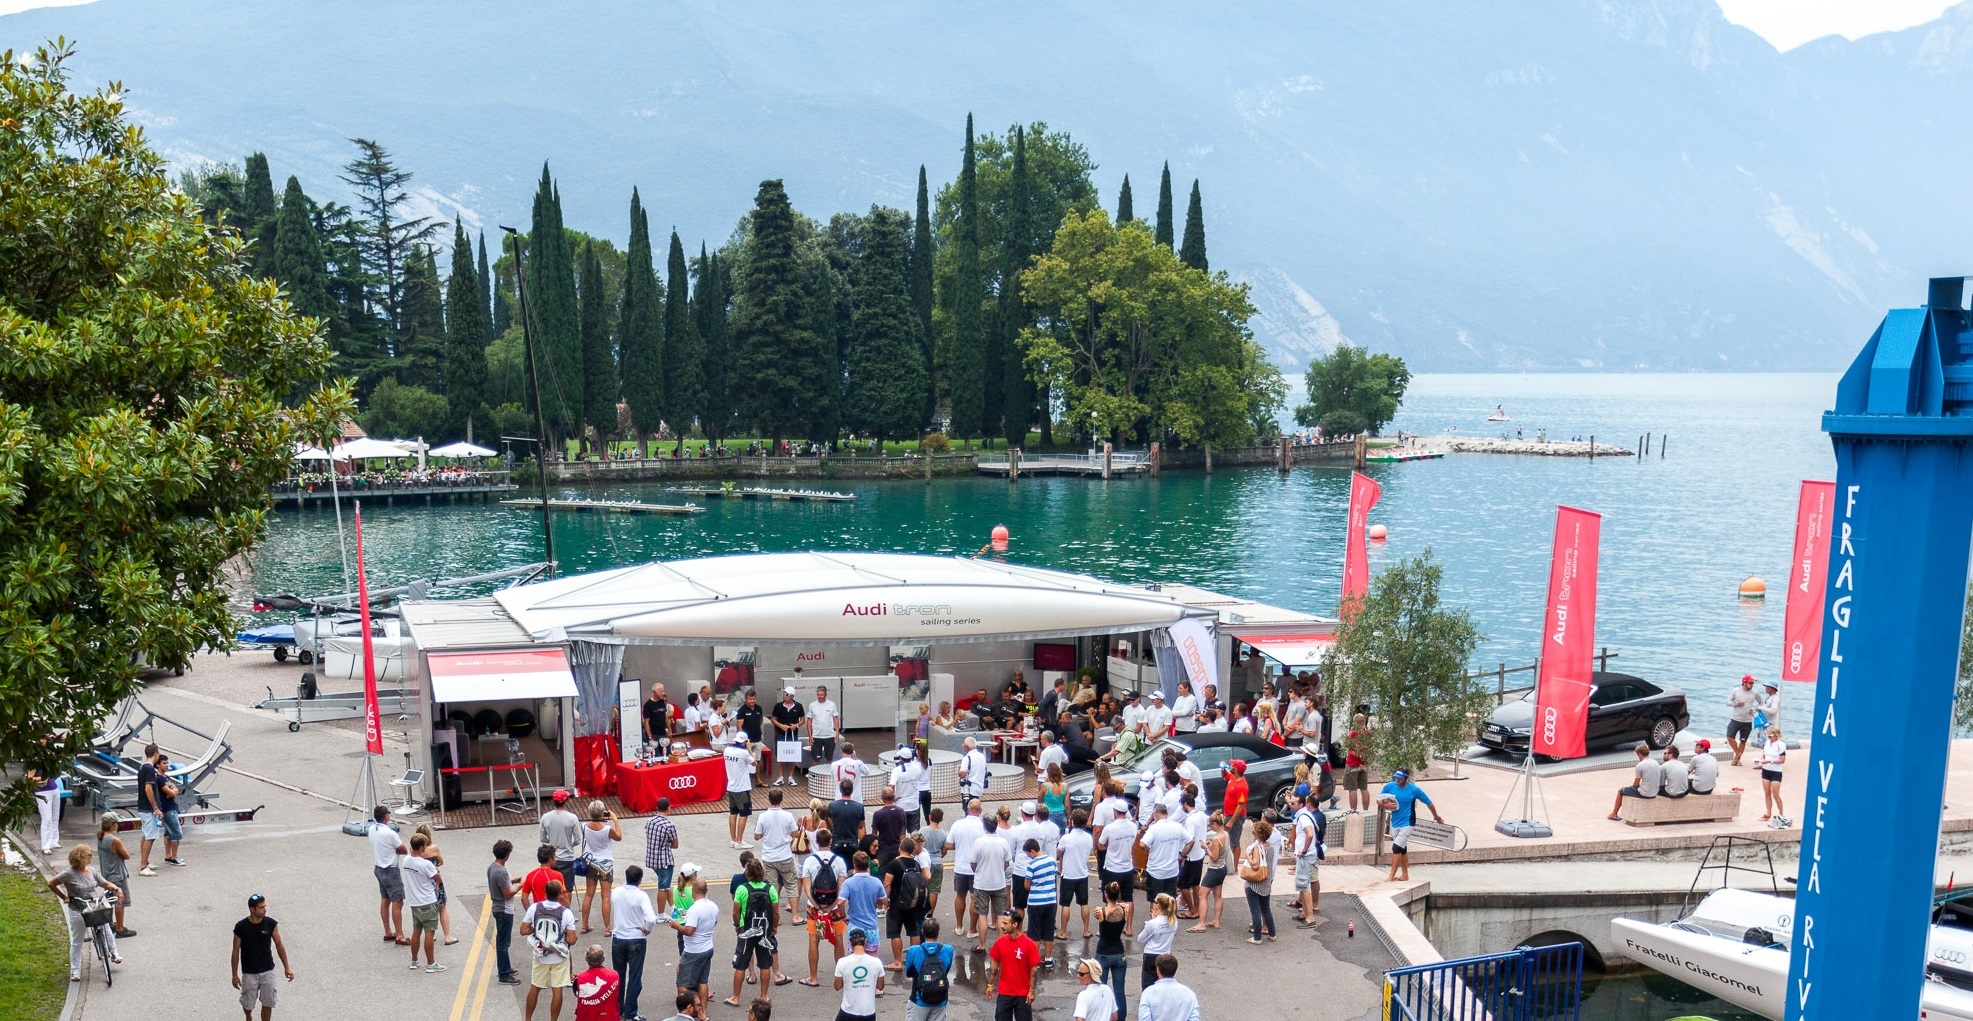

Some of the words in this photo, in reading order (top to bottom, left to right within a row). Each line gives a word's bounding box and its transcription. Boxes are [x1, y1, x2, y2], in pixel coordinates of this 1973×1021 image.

[1571, 549, 1579, 578] sailing
[1799, 560, 1812, 593] Audi
[842, 603, 887, 616] Audi
[892, 603, 952, 616] tron
[920, 617, 951, 627] sailing
[953, 617, 981, 625] series
[1552, 605, 1568, 645] Audi
[1821, 485, 1860, 738] FRAGLIA
[796, 652, 825, 661] Audi
[1807, 760, 1834, 895] VELA
[1625, 938, 1681, 967] Fratelli
[1684, 961, 1764, 997] Giacomel
[1798, 915, 1815, 1021] RIV
